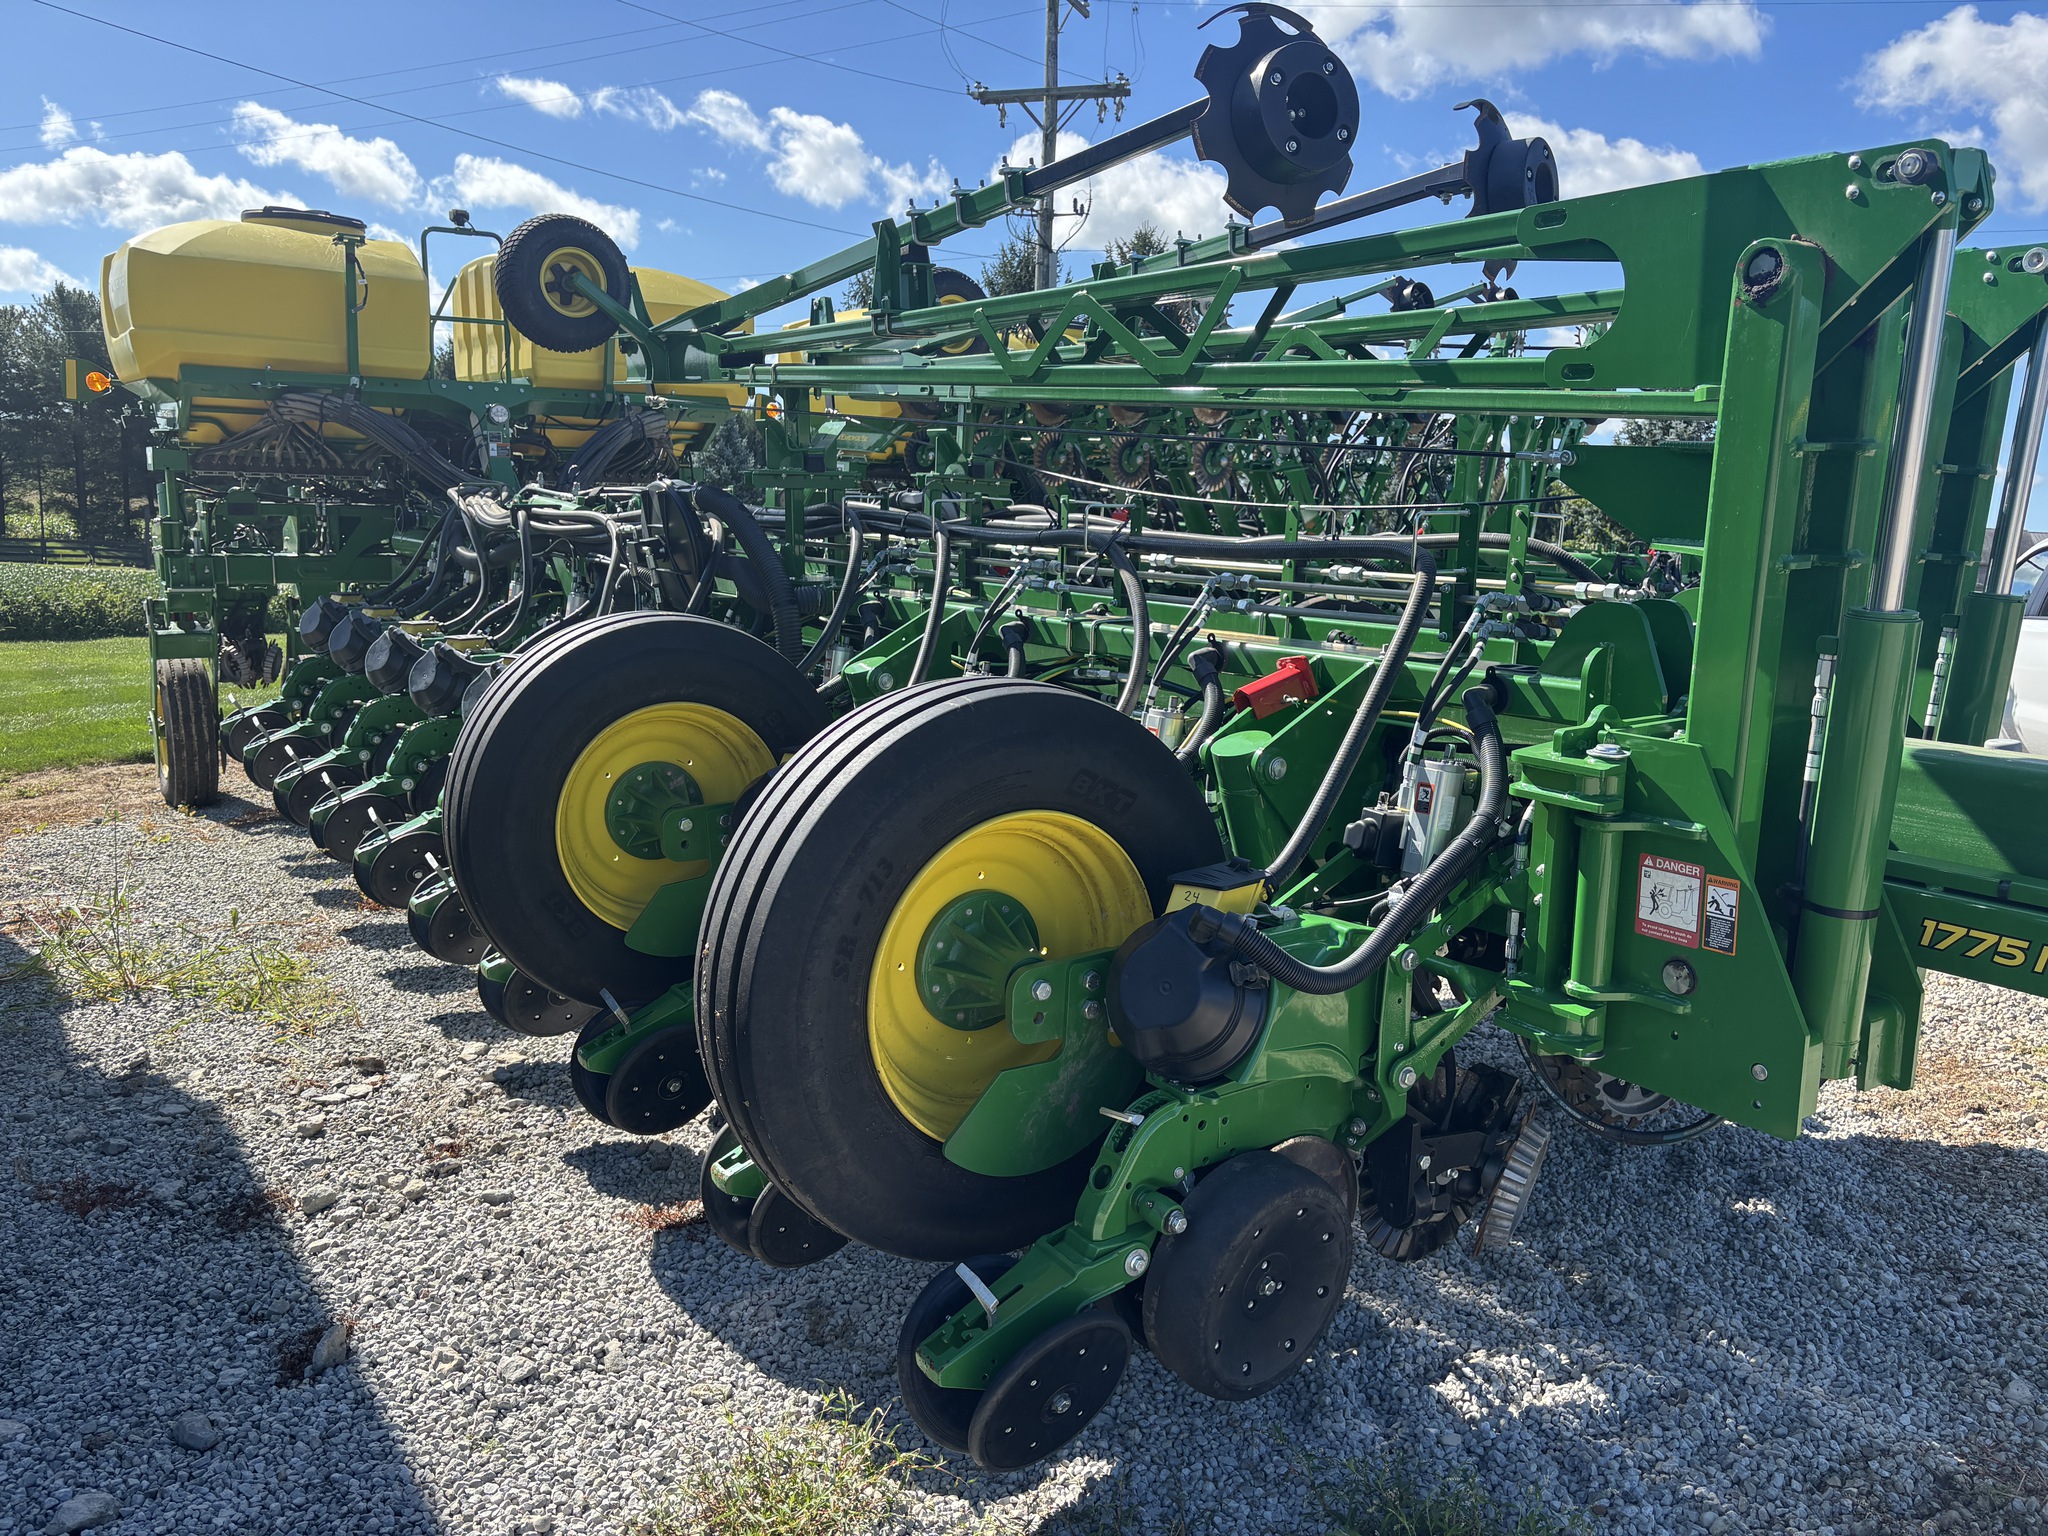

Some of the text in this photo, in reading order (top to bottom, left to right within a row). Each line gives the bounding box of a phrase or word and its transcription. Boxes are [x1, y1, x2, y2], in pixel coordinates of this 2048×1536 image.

[1068, 770, 1136, 814] BKT
[1656, 858, 1700, 877] DANGER
[1713, 878, 1738, 888] WARNING
[1184, 890, 1200, 903] 24
[1658, 926, 1670, 934] injury
[1919, 918, 2031, 967] 1775
[1587, 1121, 1605, 1131] GATES
